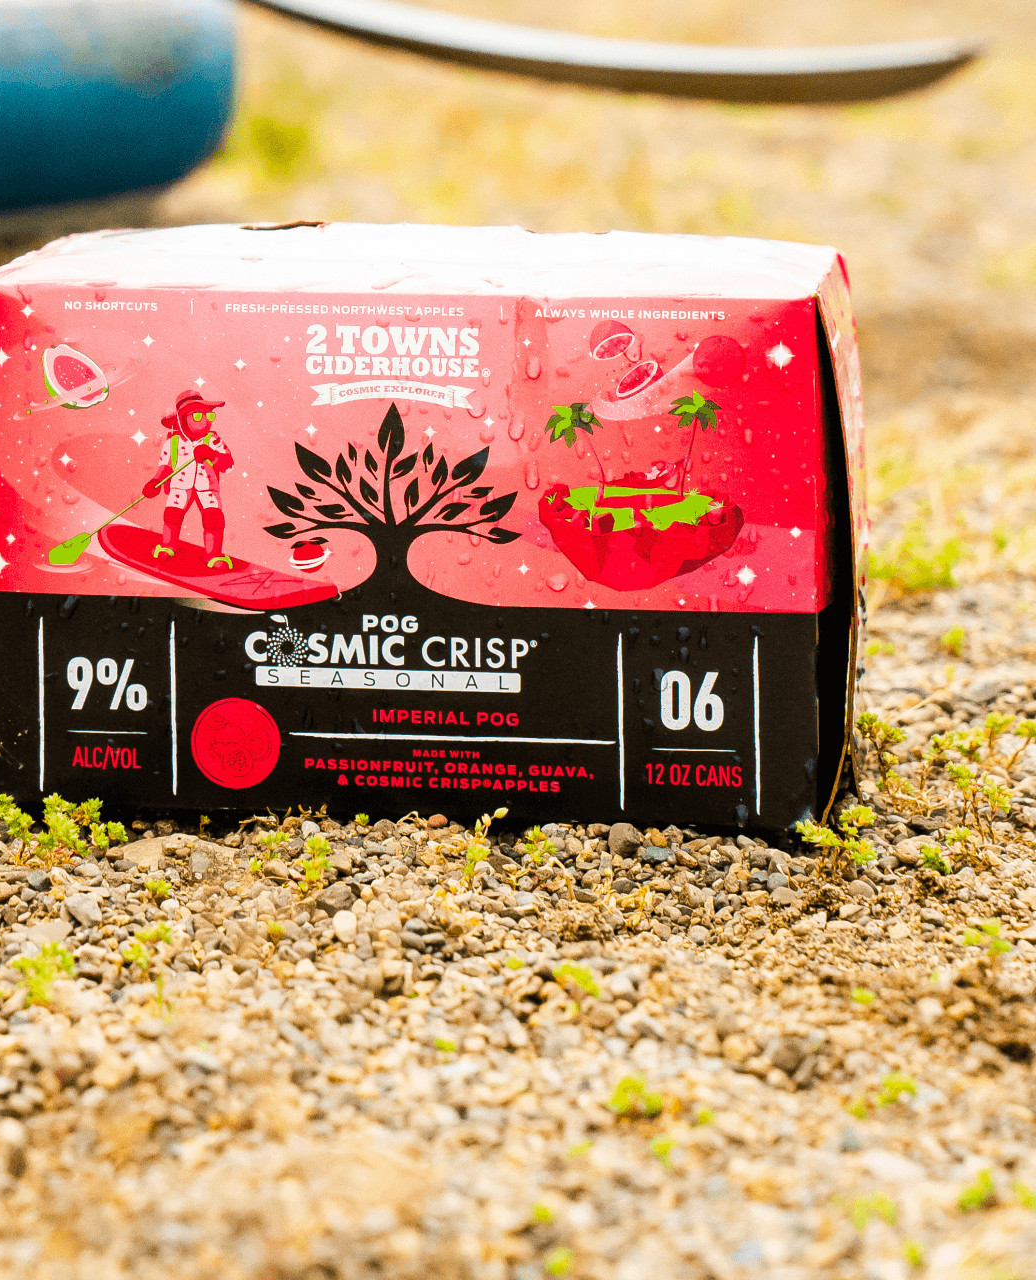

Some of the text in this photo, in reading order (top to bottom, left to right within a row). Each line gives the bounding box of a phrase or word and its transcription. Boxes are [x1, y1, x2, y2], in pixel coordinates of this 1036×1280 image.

[64, 301, 158, 311] NO SHORTCUTS
[225, 303, 464, 317] FRESH-PRESSED NORTHWEST APPLES
[535, 308, 725, 320] ALWAYS WHOLE INGREDIENTS
[306, 324, 480, 356] 2 TOWNS
[339, 385, 446, 400] COSMIC EXPLORER
[362, 614, 419, 633] POG
[244, 624, 405, 667] COSMIC
[66, 656, 148, 711] 9%
[266, 669, 510, 691] SEASONAL
[660, 670, 724, 731] 06
[372, 709, 520, 727] IMPERIAL POG
[72, 745, 142, 770] ALC/VOL
[413, 749, 480, 759] MADE WITH
[304, 758, 594, 780] PASSIONFRUIT, ORANGE, GUAVA,
[645, 763, 743, 787] 12 OZ CANS
[337, 774, 349, 786] &
[354, 774, 423, 789] COSMIC
